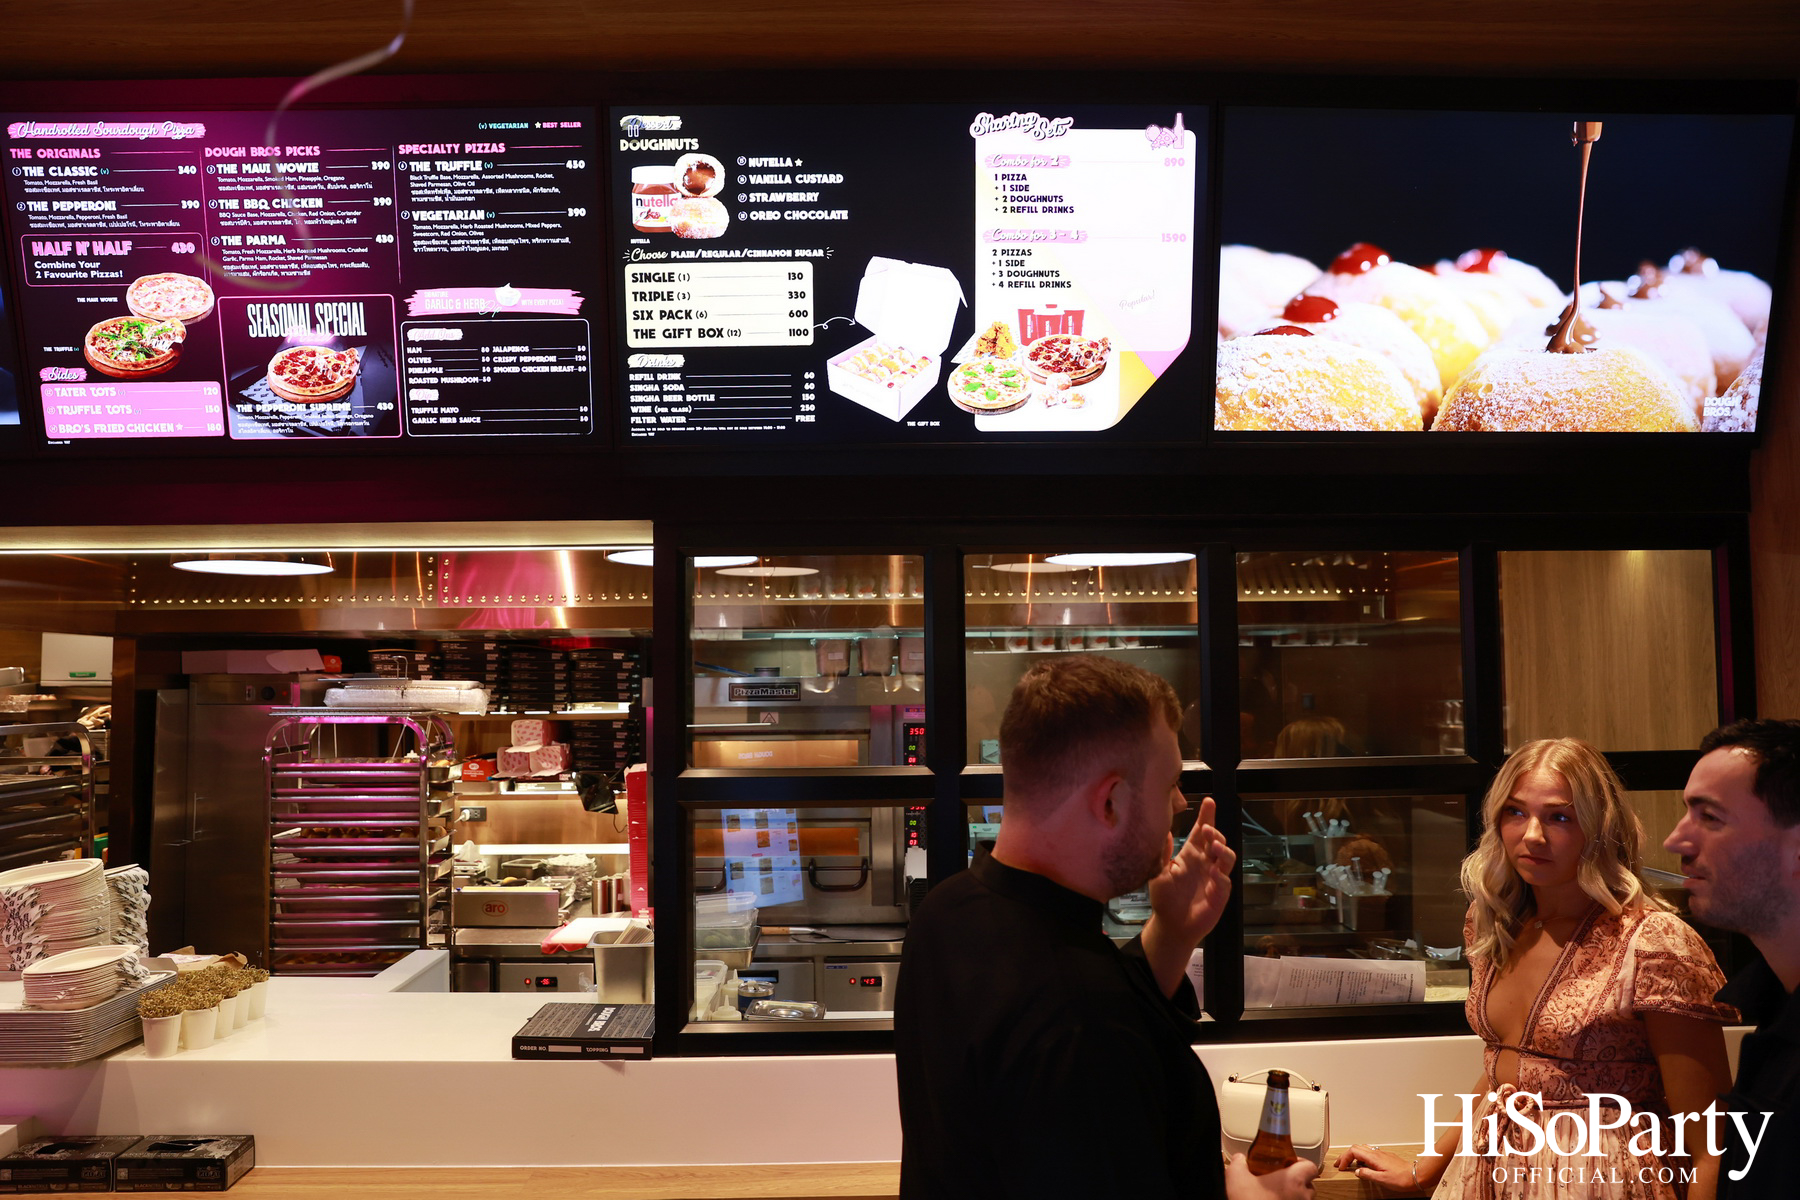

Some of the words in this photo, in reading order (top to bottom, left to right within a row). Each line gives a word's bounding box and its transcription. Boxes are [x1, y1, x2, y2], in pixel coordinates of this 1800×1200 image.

[18, 122, 90, 137] Handrolled
[93, 122, 158, 140] Sourdough
[162, 121, 195, 140] Pizza
[973, 115, 1038, 137] Sharing
[1033, 118, 1072, 140] Sets
[399, 144, 460, 154] SPECIALTY
[465, 143, 505, 154] PIZZAS
[620, 139, 699, 151] DOUGHNUTS
[10, 148, 32, 158] THE
[37, 148, 101, 158] ORIGINALS
[205, 147, 246, 157] DOUGH
[250, 146, 281, 157] BROS
[286, 146, 320, 156] PICKS
[409, 161, 431, 172] THE
[435, 160, 482, 171] TRUFFLE
[749, 158, 792, 167] NUTELLA
[991, 154, 1029, 167] Combo
[1030, 156, 1047, 168] for
[1164, 158, 1185, 167] 890
[22, 167, 44, 176] THE
[49, 166, 98, 176] CLASSIC
[178, 166, 196, 174] 340
[216, 164, 238, 174] THE
[242, 163, 271, 174] MAUI
[276, 163, 319, 173] WOWIE
[372, 162, 390, 170] 390
[749, 174, 792, 184] VANILLA
[796, 174, 843, 184] CUSTARD
[749, 192, 819, 202] STRAWBERRY
[27, 201, 48, 211] THE
[52, 200, 116, 211] PEPPERONI
[182, 200, 199, 209] 390
[218, 199, 239, 209] THE
[244, 199, 270, 210] BBQ
[272, 198, 323, 208] CHICKEN
[373, 197, 392, 206] 390
[412, 210, 484, 221] VEGETARIAN
[568, 208, 586, 217] 390
[750, 211, 781, 220] OREO
[784, 210, 848, 220] CHOCOLATE
[221, 236, 242, 245] THE
[246, 235, 286, 245] PARMA
[376, 234, 394, 243] 430
[991, 229, 1029, 241] Combo
[1030, 230, 1047, 242] for
[1162, 233, 1186, 242] 1590
[32, 241, 72, 256] HALF
[93, 241, 132, 255] HALF
[172, 242, 195, 253] 430
[631, 248, 668, 261] Choose
[795, 249, 824, 257] SUGAR
[35, 261, 76, 269] Combine
[80, 261, 100, 269] Your
[91, 270, 123, 278] Pizzas!
[632, 272, 675, 283] SINGLE
[788, 272, 803, 280] 130
[632, 291, 674, 302] TRIPLE
[425, 299, 454, 309] GARLIC
[463, 299, 485, 309] HERB
[247, 303, 311, 337] SEASONAL
[315, 302, 367, 336] SPECIAL
[633, 310, 653, 320] SIX
[660, 310, 692, 320] PACK
[696, 311, 707, 319] (6)
[634, 329, 656, 339] THE
[662, 328, 692, 339] GIFT
[698, 328, 724, 338] BOX
[727, 329, 741, 337] (12)
[637, 355, 677, 367] Drinks
[48, 368, 79, 380] Sides
[55, 388, 86, 397] TATER
[90, 387, 116, 396] TOTS
[204, 387, 218, 395] 120
[57, 406, 104, 414] TRUFFLE
[107, 405, 132, 414] TOTS
[236, 404, 252, 412] THE
[256, 404, 307, 412] PEPPERONI
[59, 424, 90, 434] BRO'S
[94, 424, 125, 433] FRIED
[127, 423, 174, 432] CHICKEN
[207, 423, 222, 431] 180
[485, 904, 505, 913] aro
